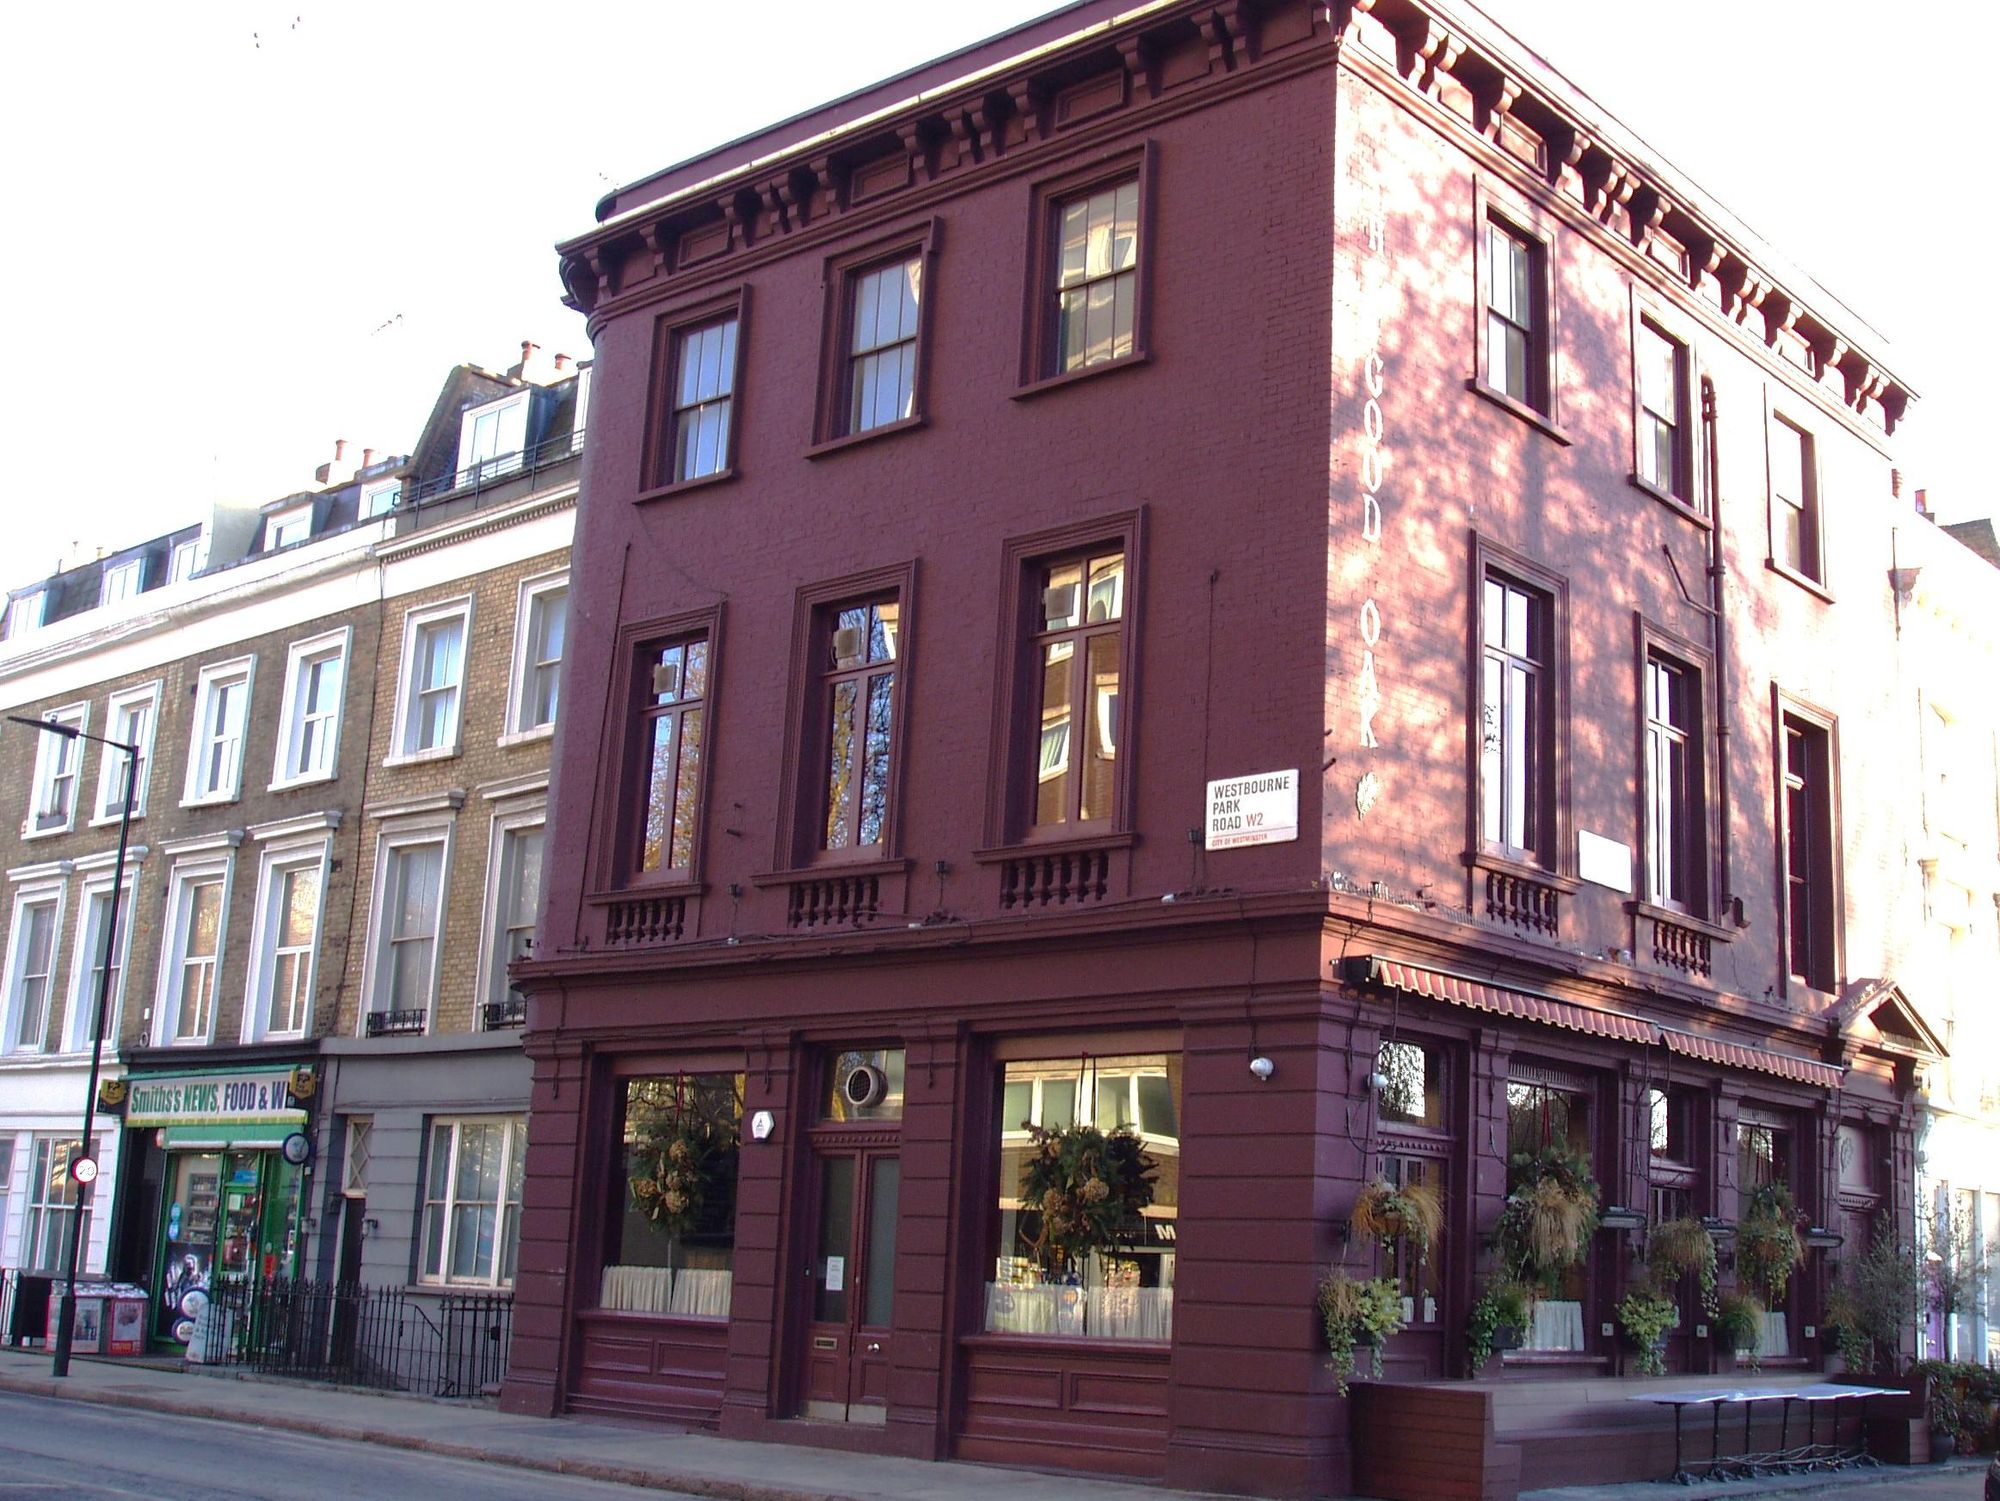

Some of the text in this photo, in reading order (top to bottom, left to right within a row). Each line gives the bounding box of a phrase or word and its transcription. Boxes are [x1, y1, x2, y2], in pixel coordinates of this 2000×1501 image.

[1359, 351, 1384, 749] GOOD OAK
[1214, 776, 1290, 800] WESTBOURNE
[1213, 799, 1241, 816] PARK
[1212, 812, 1264, 832] ROAD W2
[131, 1085, 182, 1113] Smiths's
[183, 1083, 220, 1114] NEWS,
[223, 1081, 257, 1112] FOOD
[258, 1085, 268, 1110] &
